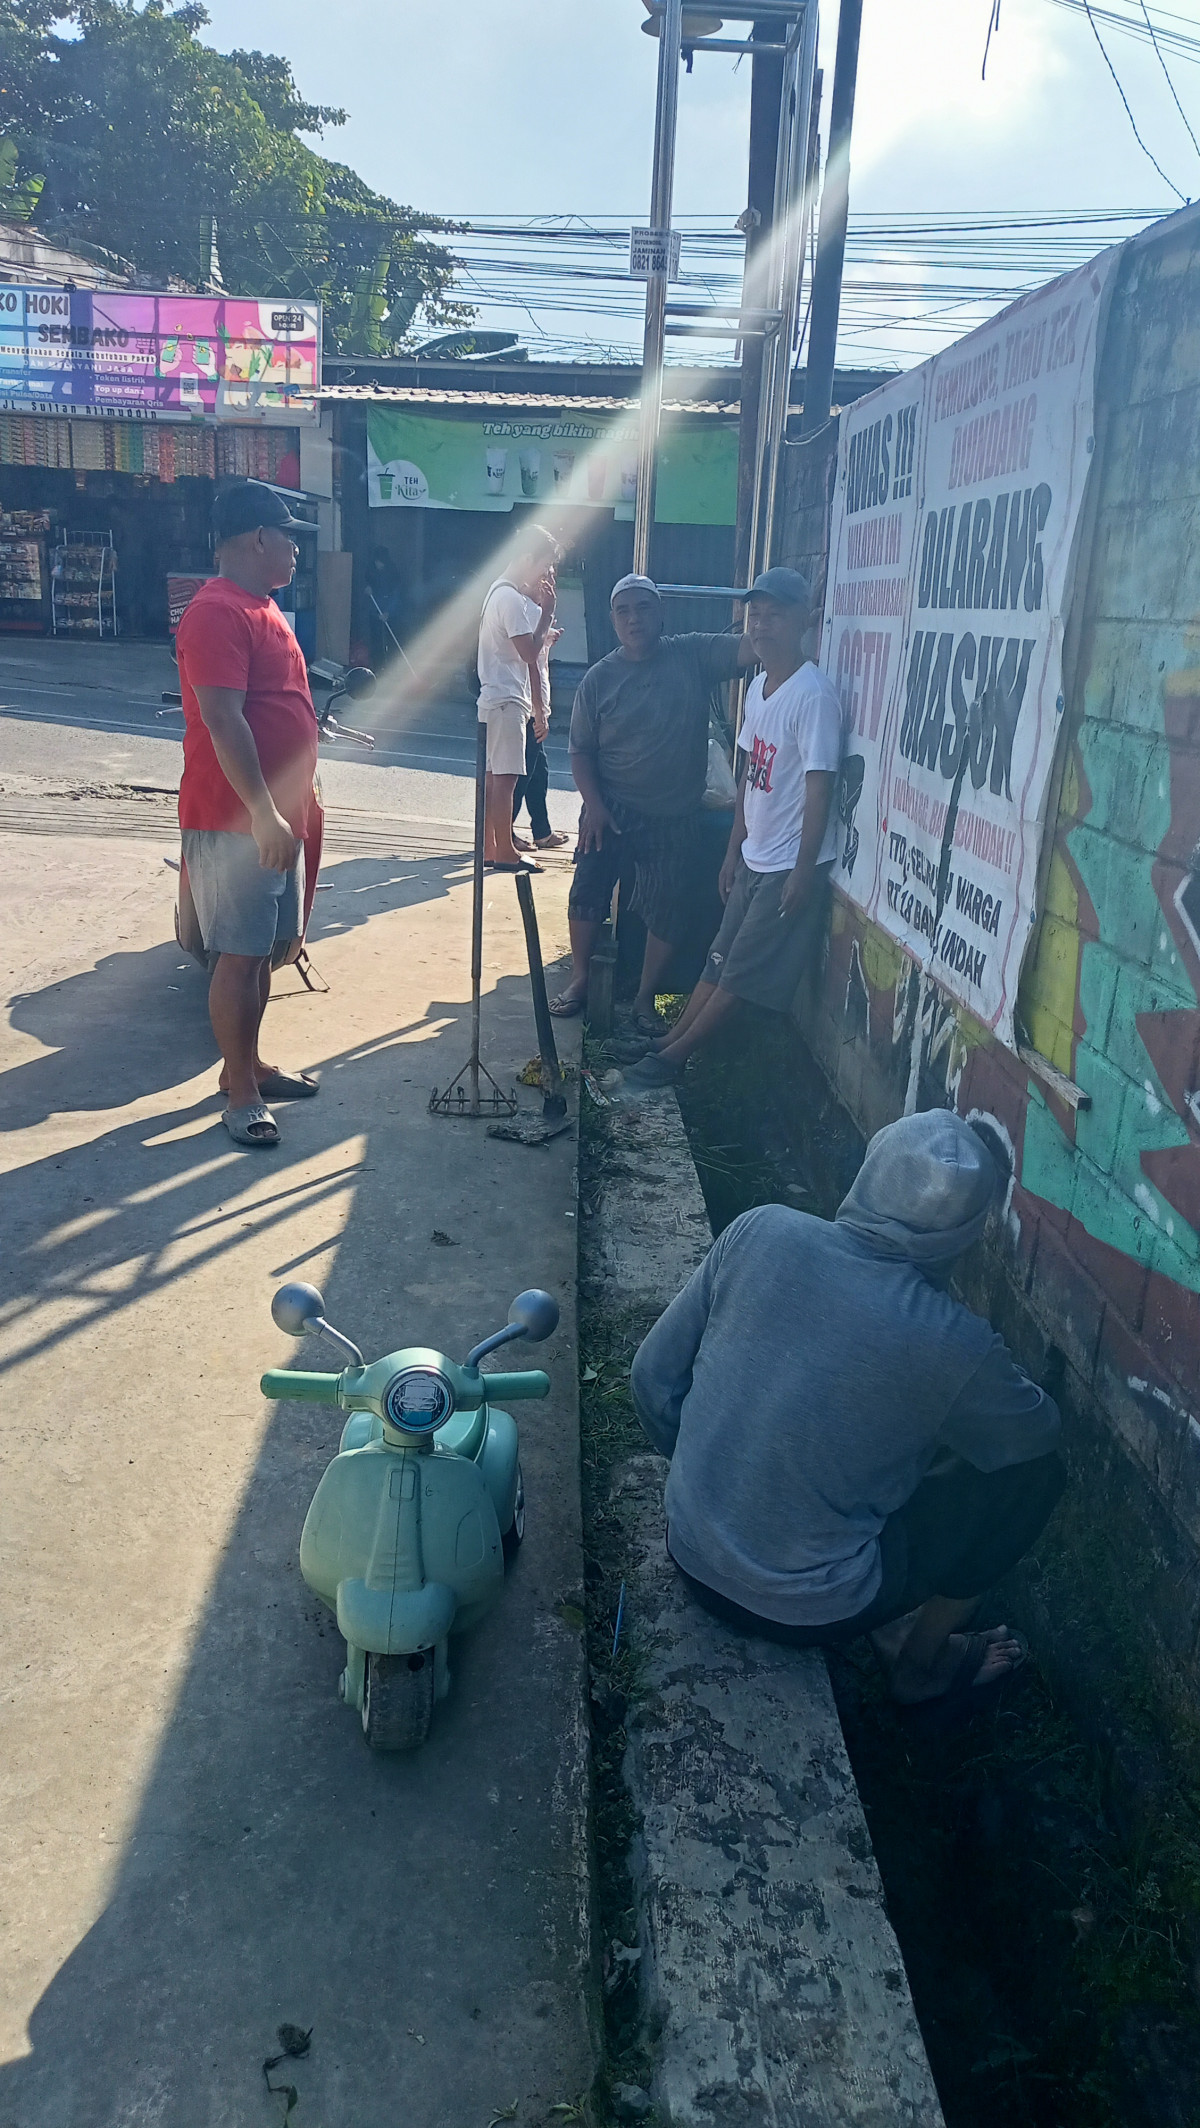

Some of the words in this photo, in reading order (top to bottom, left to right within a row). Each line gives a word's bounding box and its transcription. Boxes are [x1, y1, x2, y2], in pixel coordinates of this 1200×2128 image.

[632, 247, 666, 255] JAMINAN
[632, 254, 650, 271] 0821
[26, 293, 69, 315] HOKI
[273, 314, 291, 322] OPEN
[292, 315, 302, 323] 24
[38, 324, 129, 348] SEMBAKO
[1002, 318, 1048, 392] TAMU
[94, 384, 110, 394] Top
[112, 387, 122, 396] up
[124, 387, 145, 395] dana
[95, 374, 120, 383] Token
[121, 375, 146, 384] listrik
[32, 402, 77, 415] Sultan
[95, 396, 146, 408] Pembayaran
[483, 422, 511, 436] Teh
[511, 424, 551, 440] yang
[552, 423, 594, 439] bikin
[948, 392, 1038, 490] DIUNDANG
[846, 413, 894, 516] AWAS
[396, 484, 422, 500] Kita
[403, 476, 419, 485] TEH
[847, 516, 885, 571] WILAYAH
[885, 511, 902, 566] INI
[917, 482, 1053, 612] DILARANG
[836, 629, 892, 743] CCTV
[900, 630, 1037, 802] MASUK
[972, 815, 1006, 870] INDAH
[955, 875, 1003, 938] WARGA
[887, 878, 901, 912] RT
[900, 888, 915, 924] 18
[940, 928, 987, 989] INDAH
